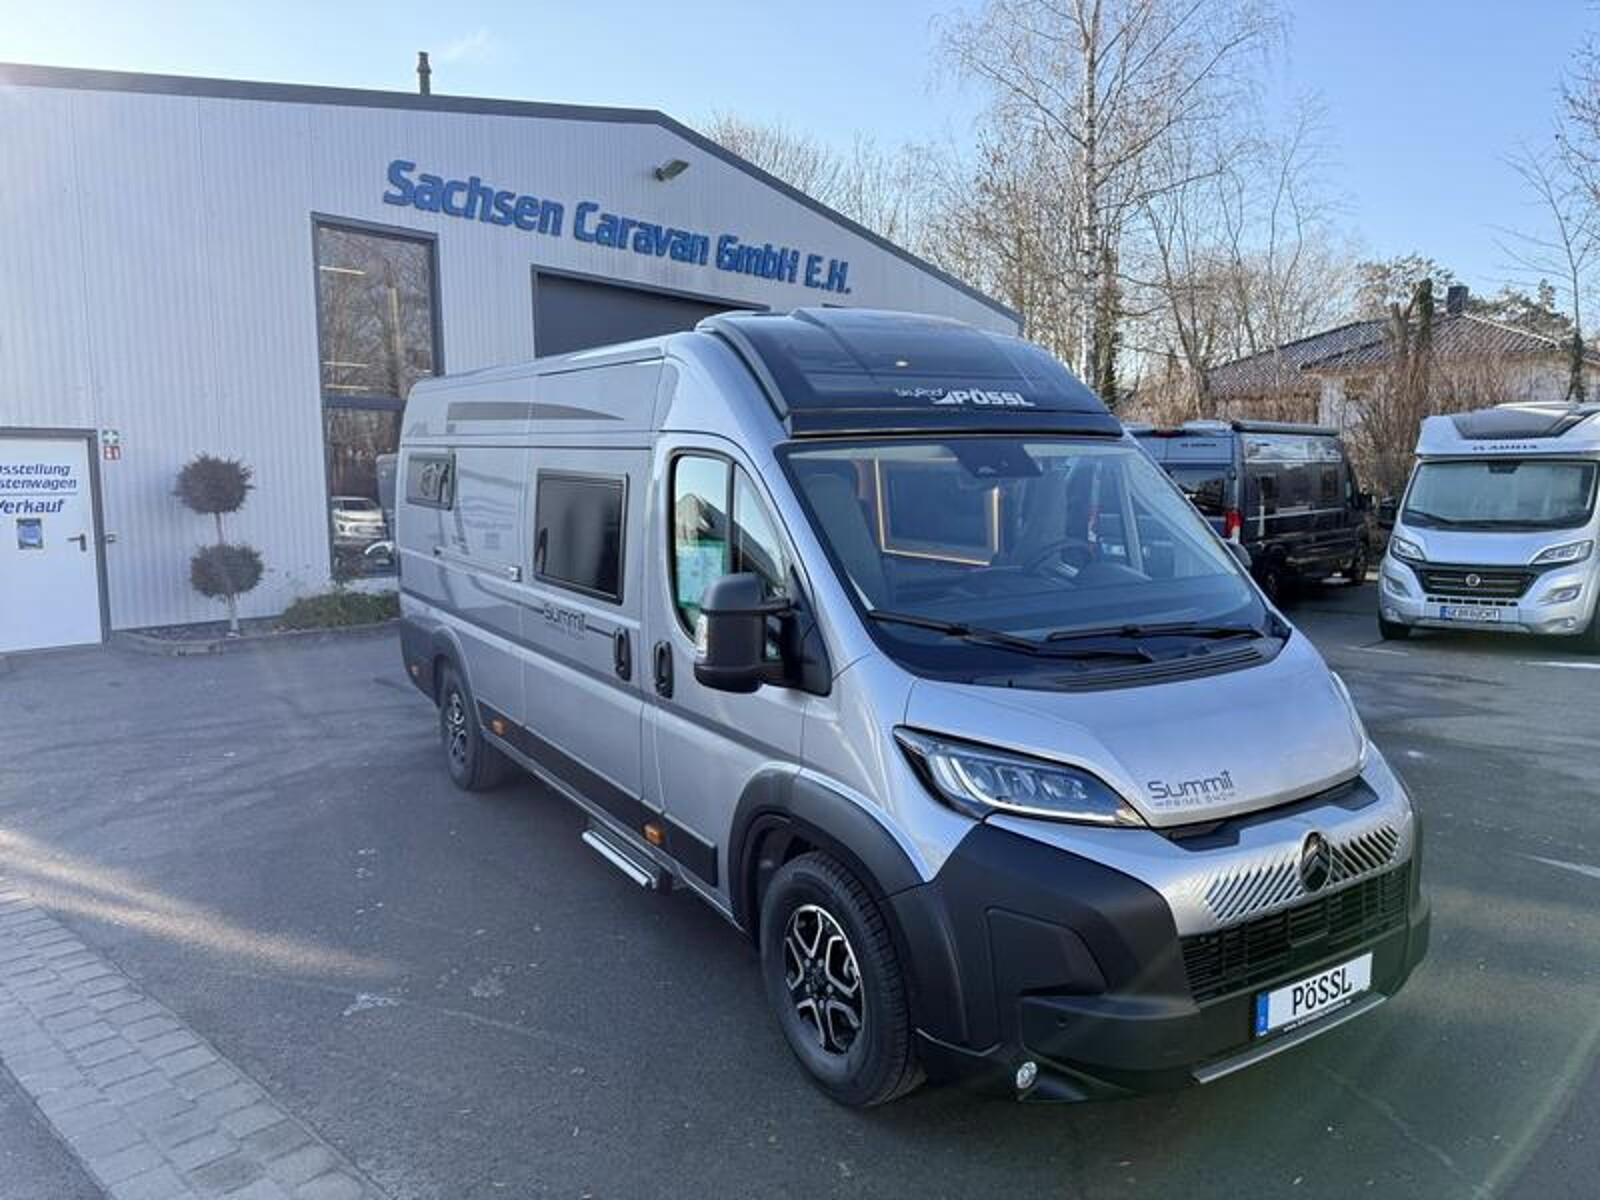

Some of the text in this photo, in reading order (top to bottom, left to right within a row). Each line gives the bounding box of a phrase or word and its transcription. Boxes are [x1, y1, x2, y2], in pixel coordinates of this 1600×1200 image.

[384, 159, 852, 294] Sachsen Caravan GmbH E.H.
[950, 388, 1035, 406] PÖSSL
[1147, 770, 1234, 800] Summit
